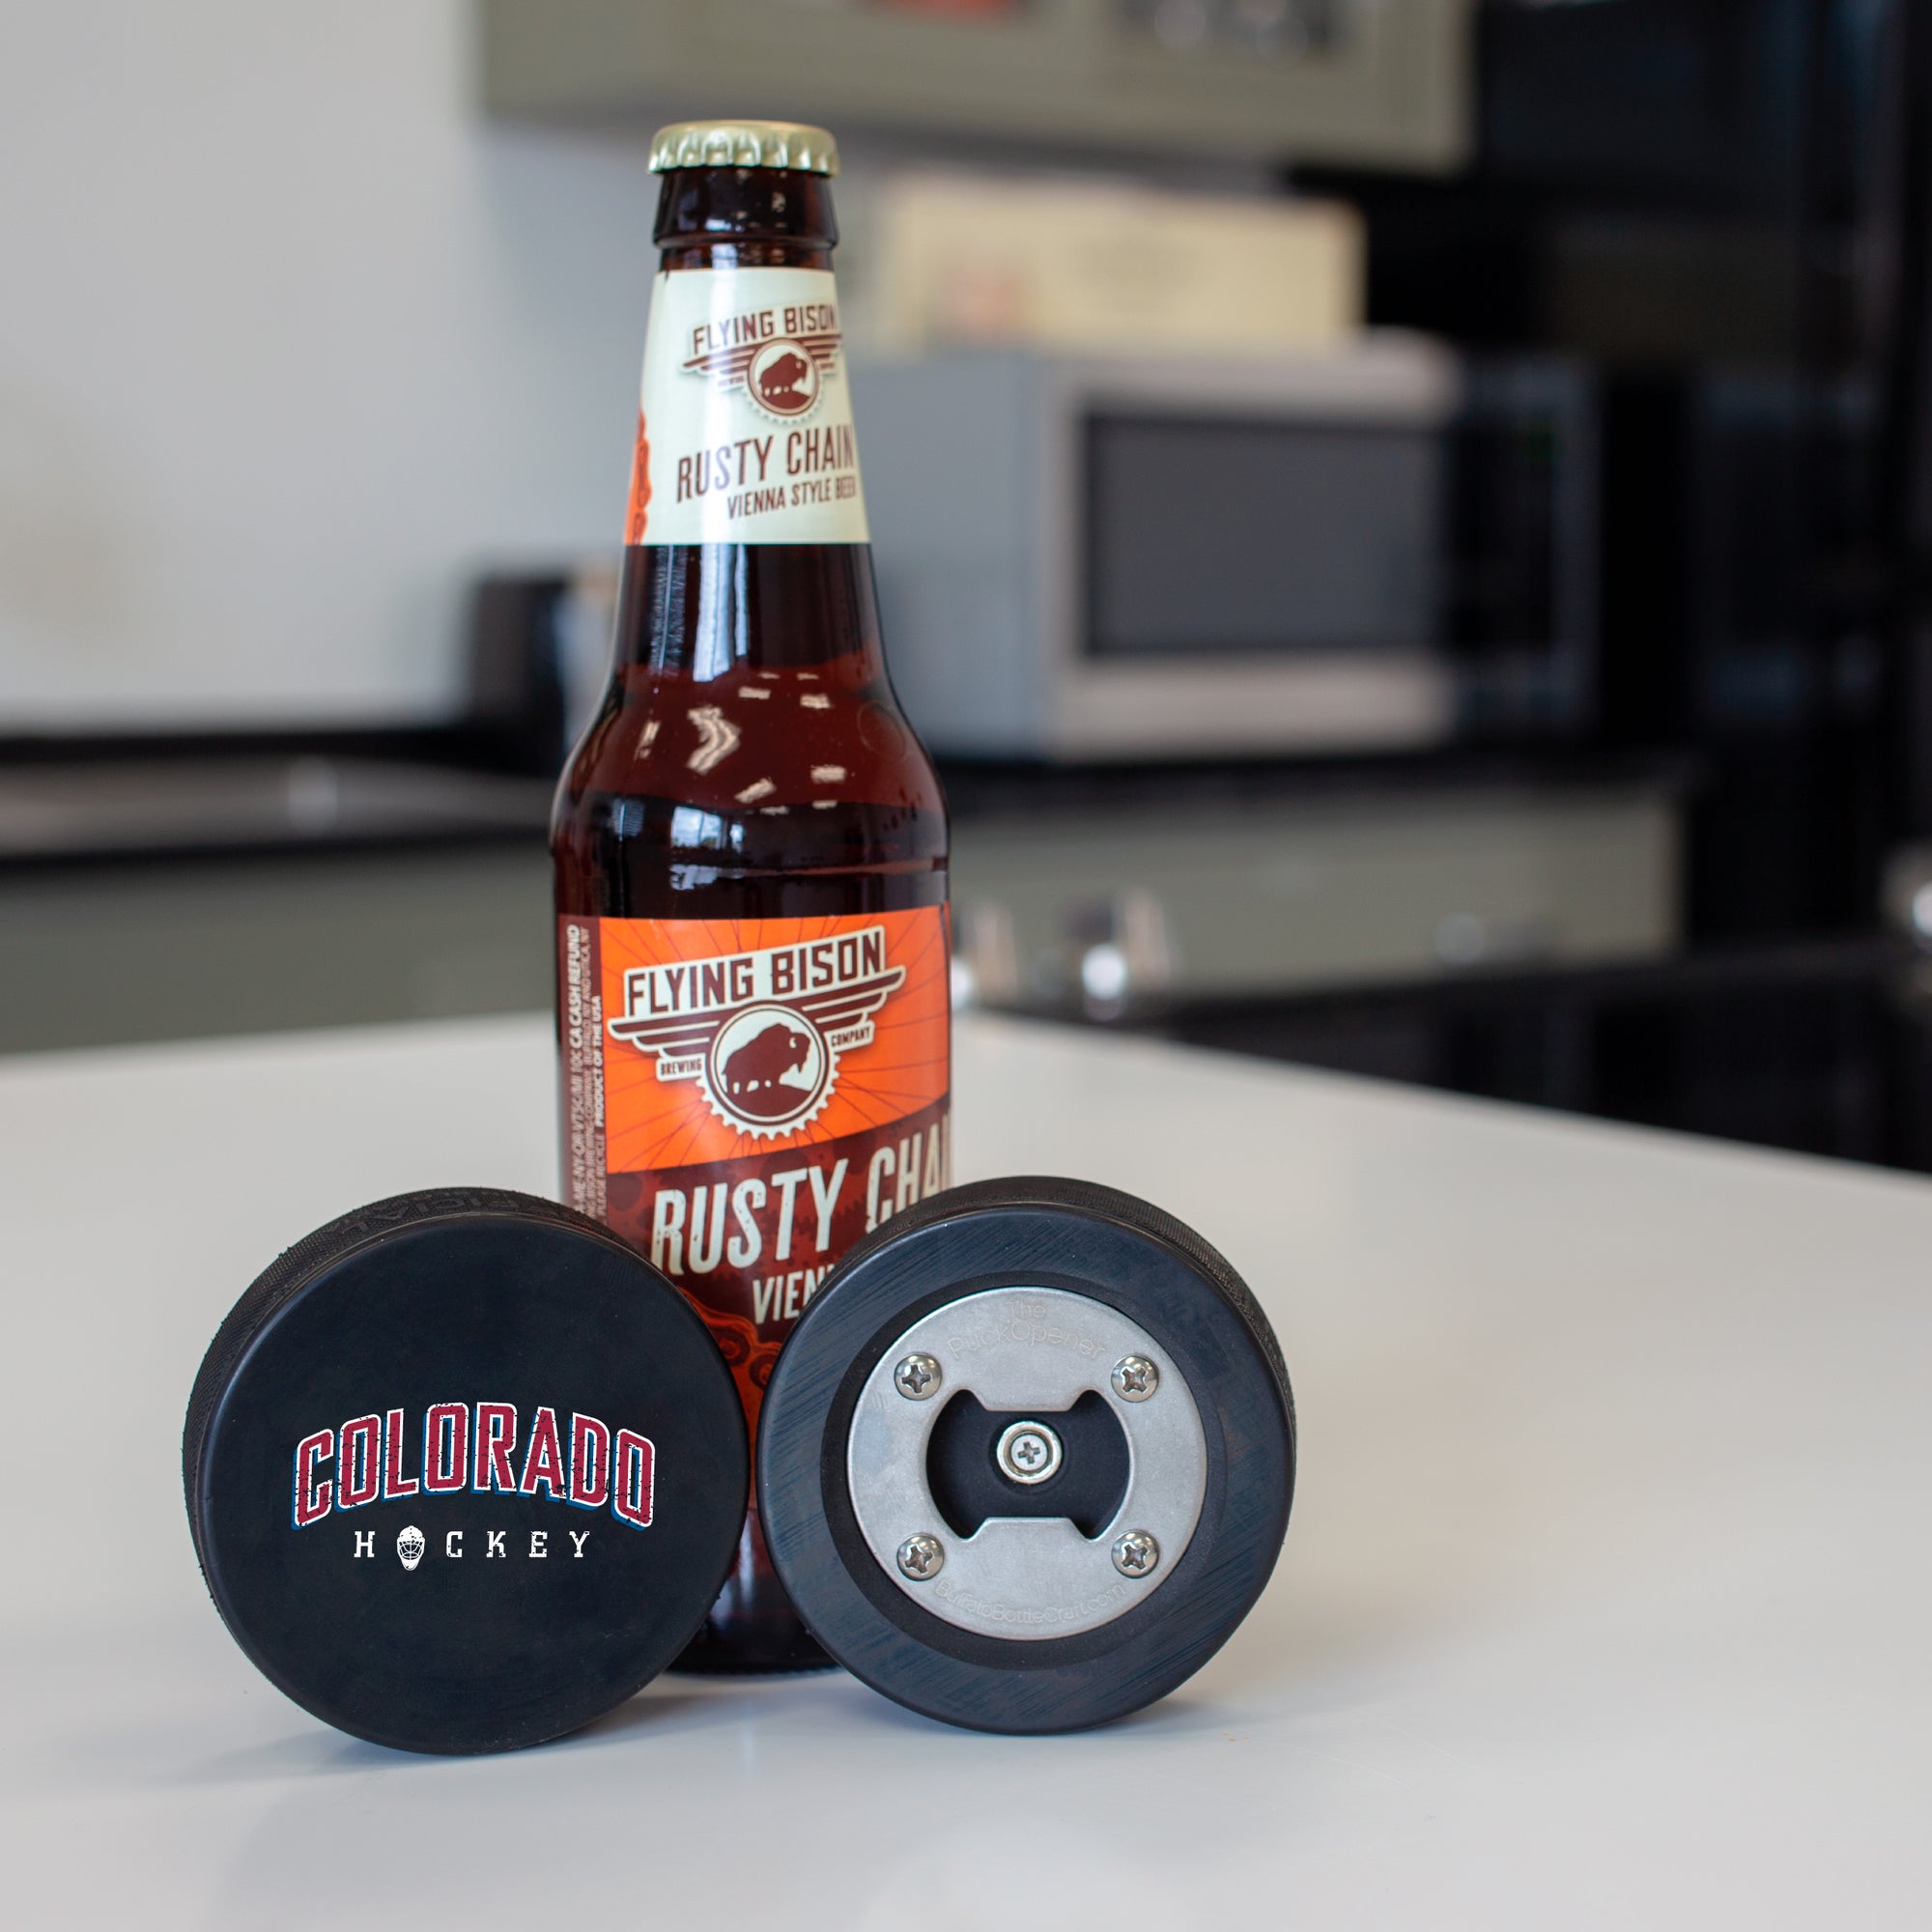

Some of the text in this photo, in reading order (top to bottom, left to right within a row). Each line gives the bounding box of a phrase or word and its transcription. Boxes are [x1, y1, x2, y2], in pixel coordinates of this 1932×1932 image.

[693, 303, 838, 355] FLYING BISON
[676, 423, 855, 503] RUSTY CHAIN
[726, 487, 786, 520] VIENNA
[791, 478, 832, 507] STYLE
[566, 924, 581, 985] REFUND
[628, 930, 885, 1017] FLYING BISON
[567, 985, 582, 1026] CASH
[591, 995, 602, 1022] USA
[568, 1027, 582, 1048] CA
[591, 1023, 603, 1046] THE
[592, 1048, 603, 1066] OF
[661, 1026, 870, 1076] BREWING COMPANY
[593, 1067, 604, 1127] PRODUCT
[651, 1158, 849, 1276] RUSTY
[753, 1264, 836, 1324] VIEN
[1006, 1300, 1046, 1318] The
[291, 1402, 656, 1530] COLORADO
